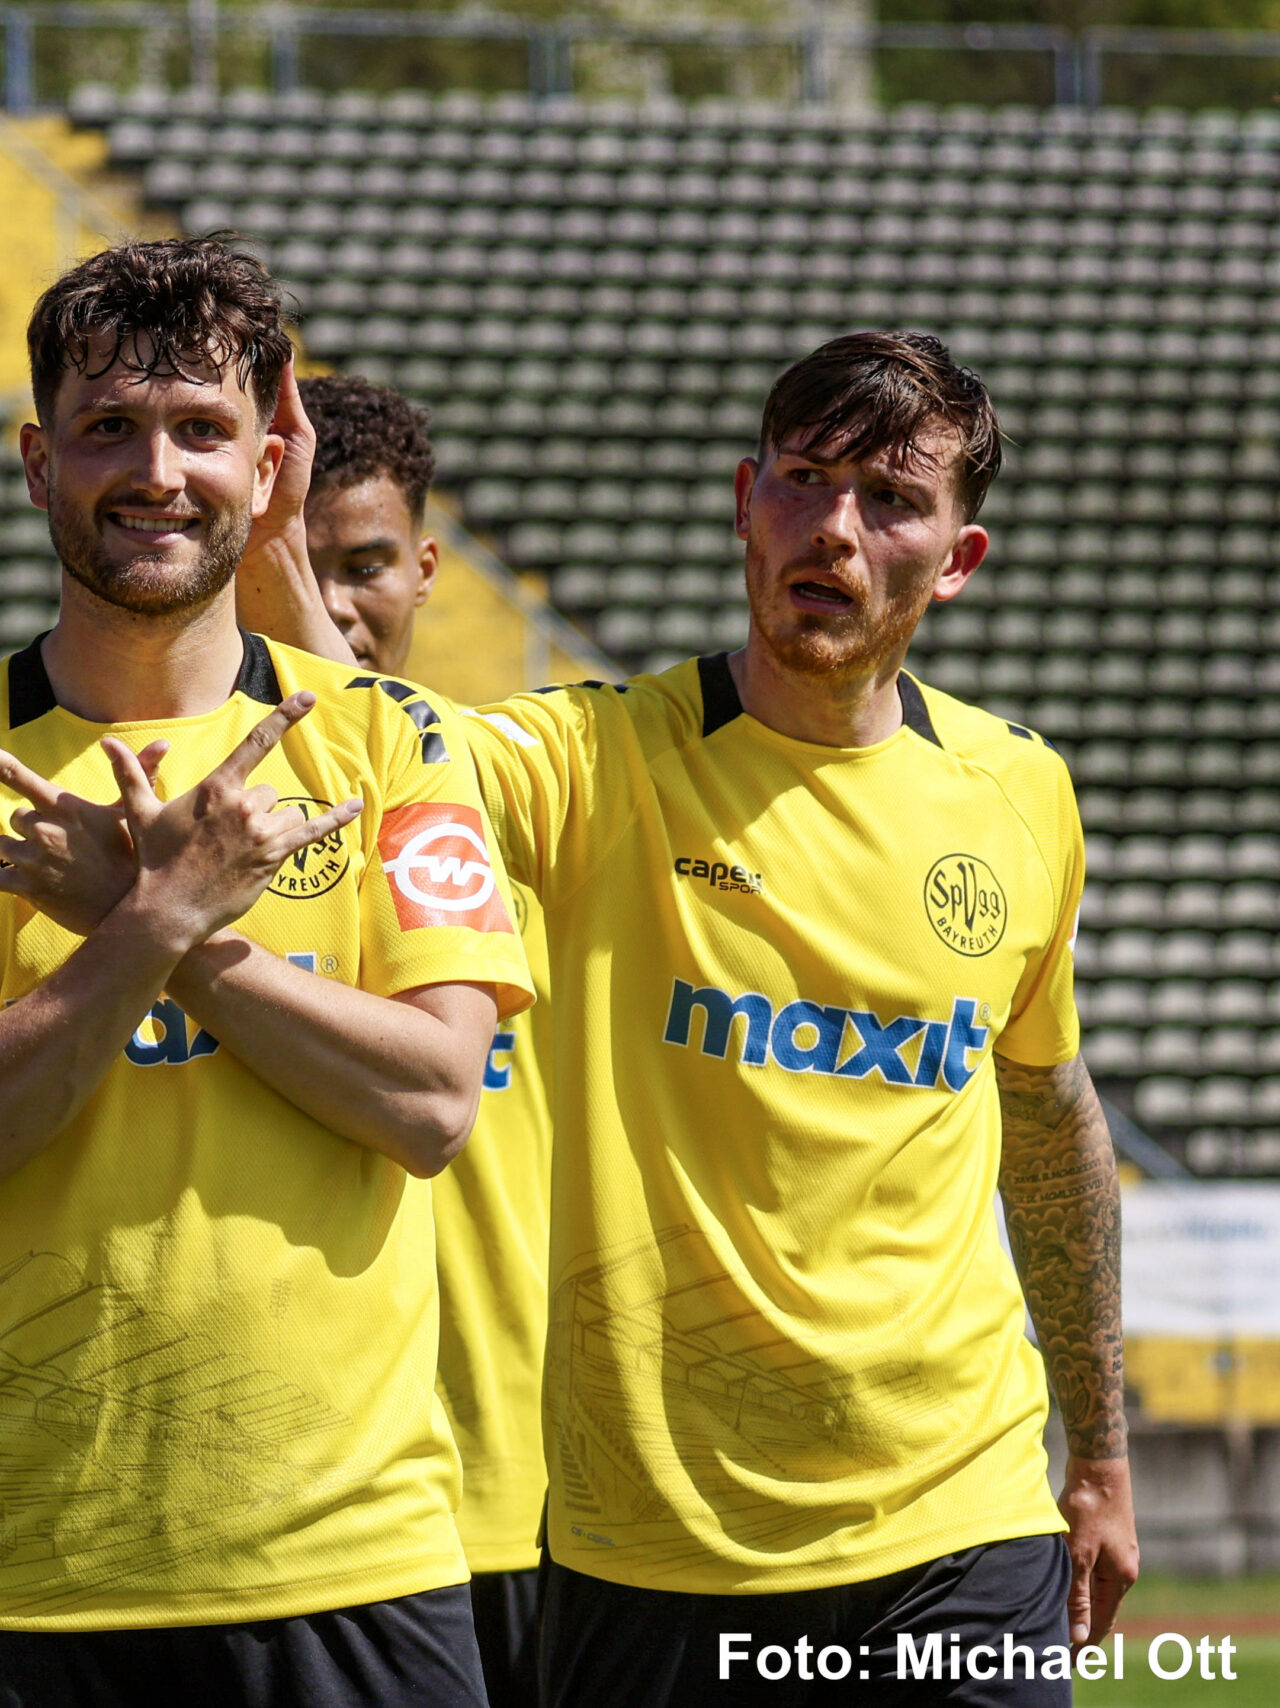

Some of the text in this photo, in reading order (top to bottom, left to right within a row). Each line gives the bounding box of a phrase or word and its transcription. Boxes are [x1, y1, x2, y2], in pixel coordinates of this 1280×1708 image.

[278, 859, 340, 892] YREUTH
[719, 881, 765, 898] SPOR
[929, 861, 1001, 933] SpVgg
[936, 915, 999, 950] BAYREUTH
